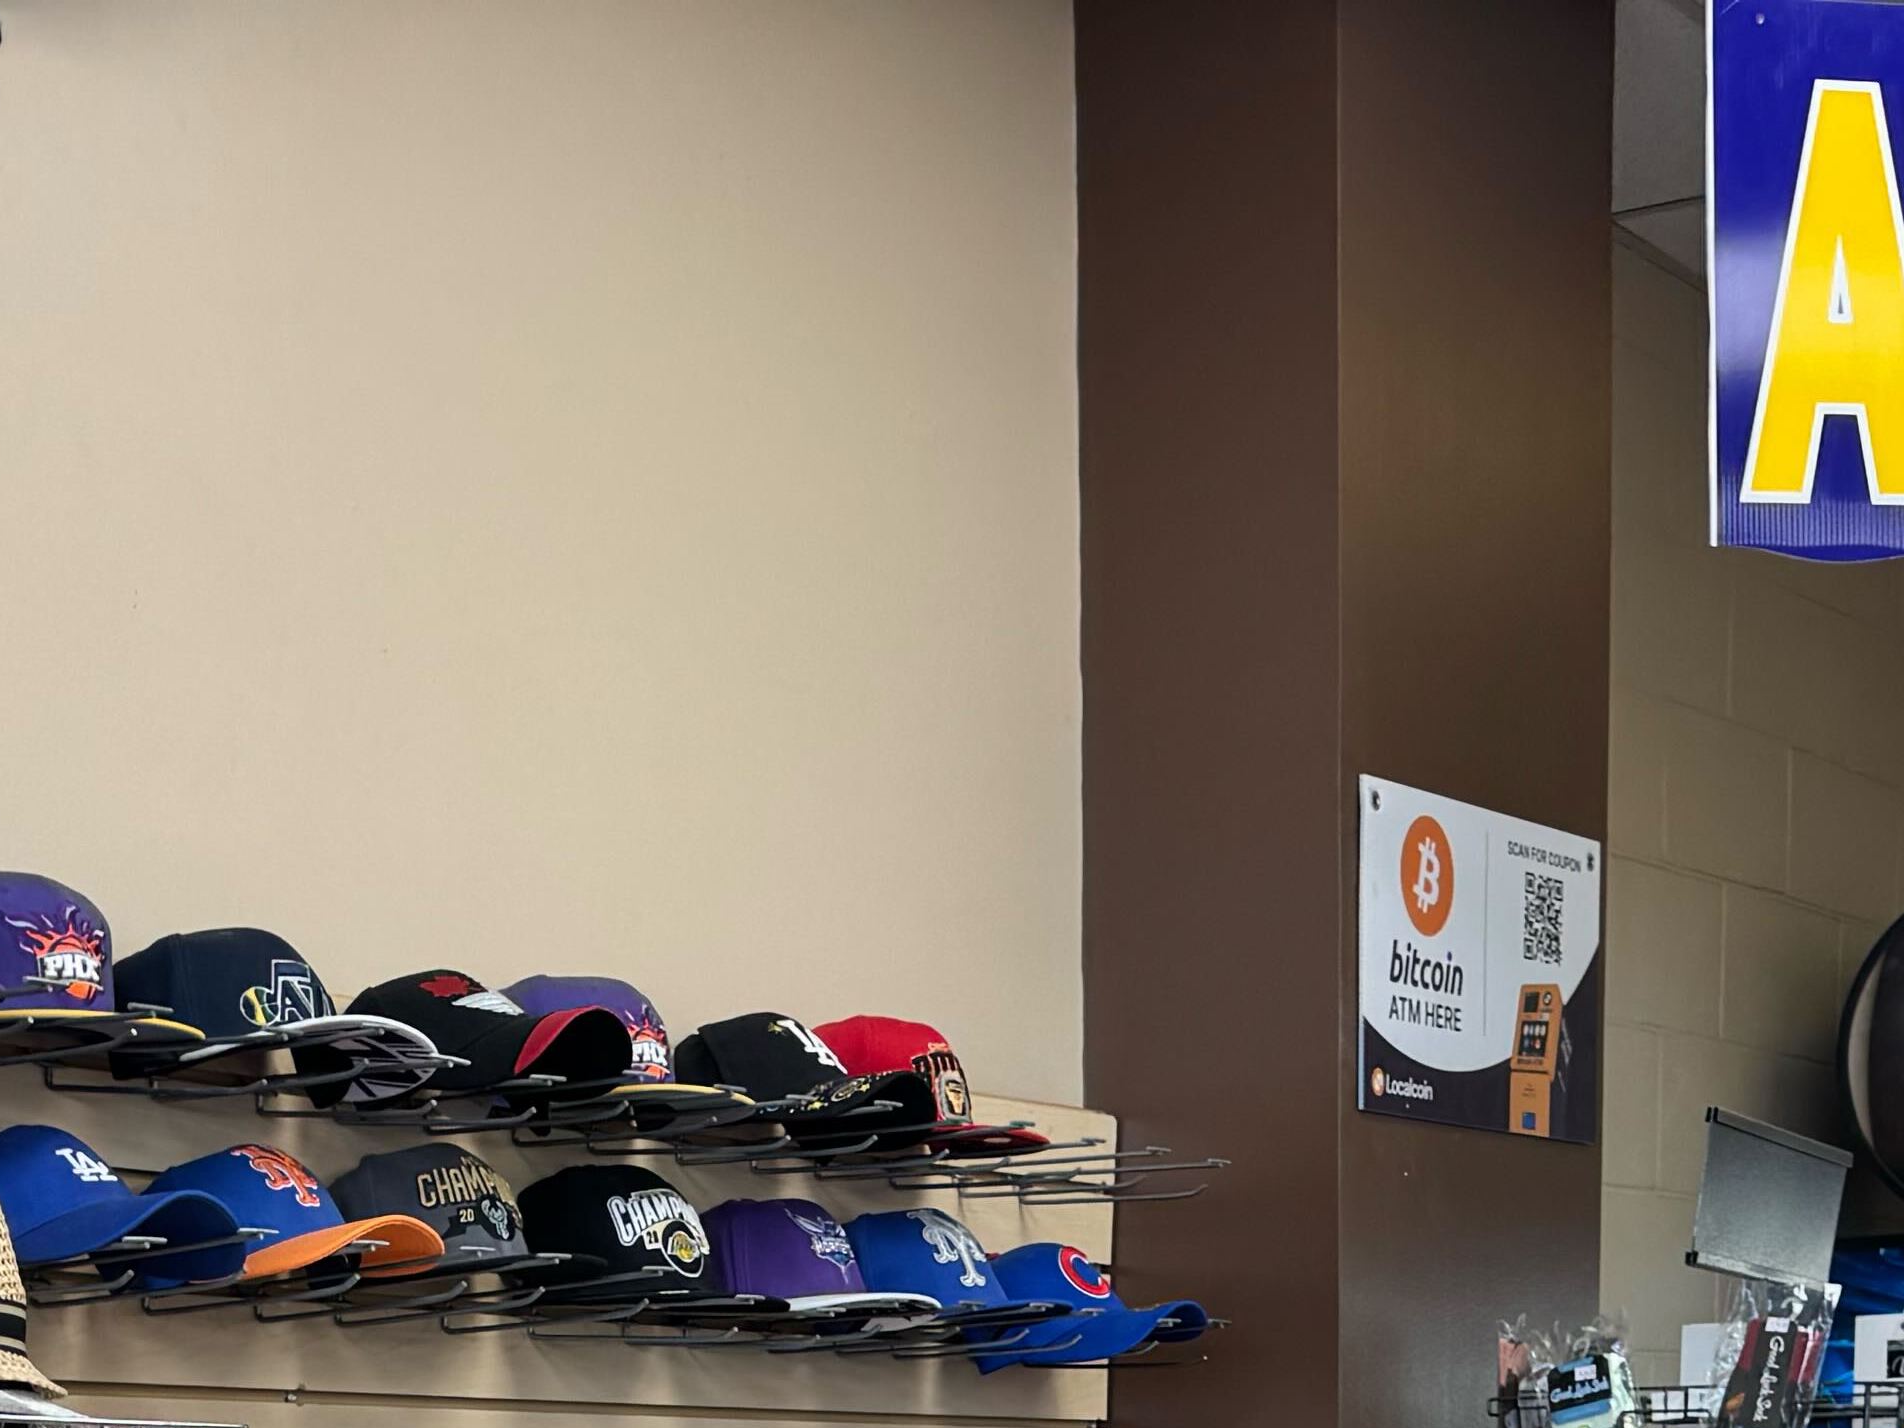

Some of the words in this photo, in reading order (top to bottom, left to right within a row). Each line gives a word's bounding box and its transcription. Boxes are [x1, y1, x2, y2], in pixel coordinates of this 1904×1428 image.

[1507, 841, 1531, 860] SCAN
[1531, 847, 1547, 864] FOR
[1548, 851, 1581, 873] COUPON
[43, 957, 101, 981] PHX
[1390, 940, 1464, 996] bitcoin
[1389, 996, 1422, 1027] ATM
[1424, 1003, 1463, 1032] HERE
[1385, 1074, 1433, 1101] Localcoin
[56, 1148, 117, 1181] LA
